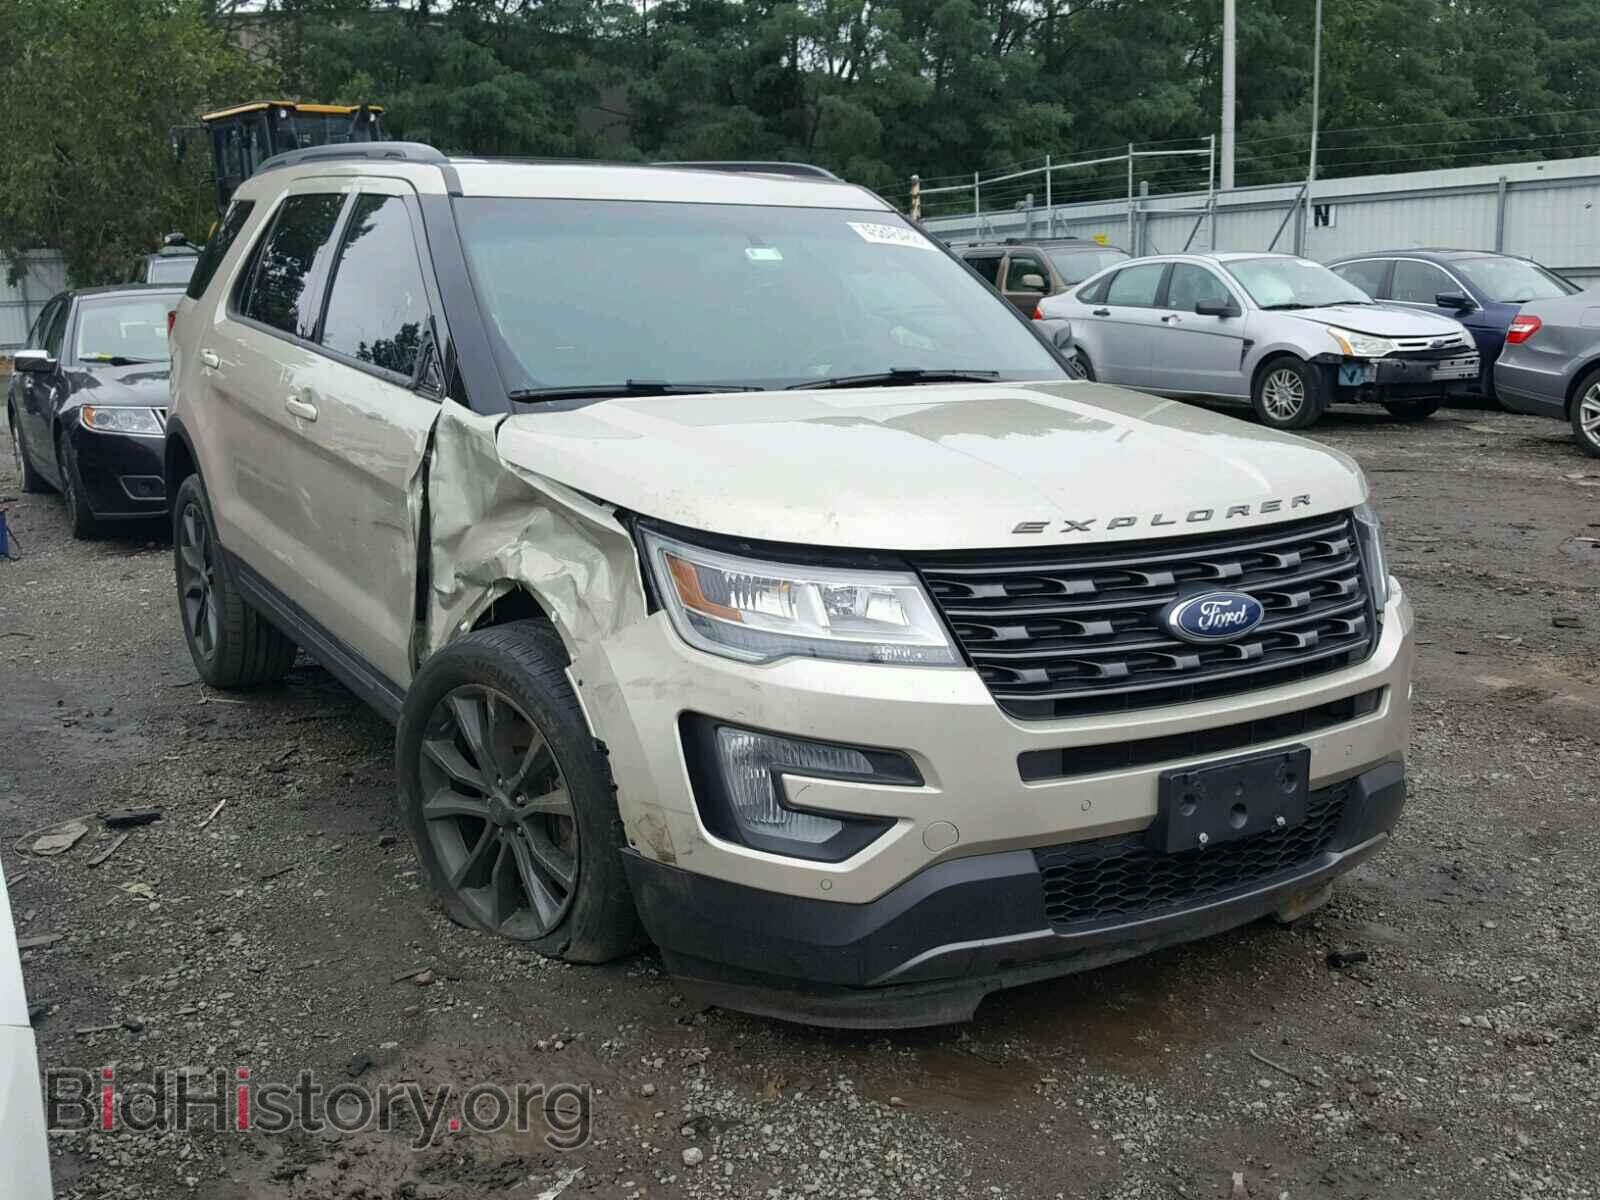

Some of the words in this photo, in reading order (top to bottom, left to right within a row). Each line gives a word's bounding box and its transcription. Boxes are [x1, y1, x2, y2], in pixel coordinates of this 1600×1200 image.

[1314, 204, 1330, 226] N
[1011, 494, 1312, 534] EXPLORER
[1197, 599, 1249, 630] Ford
